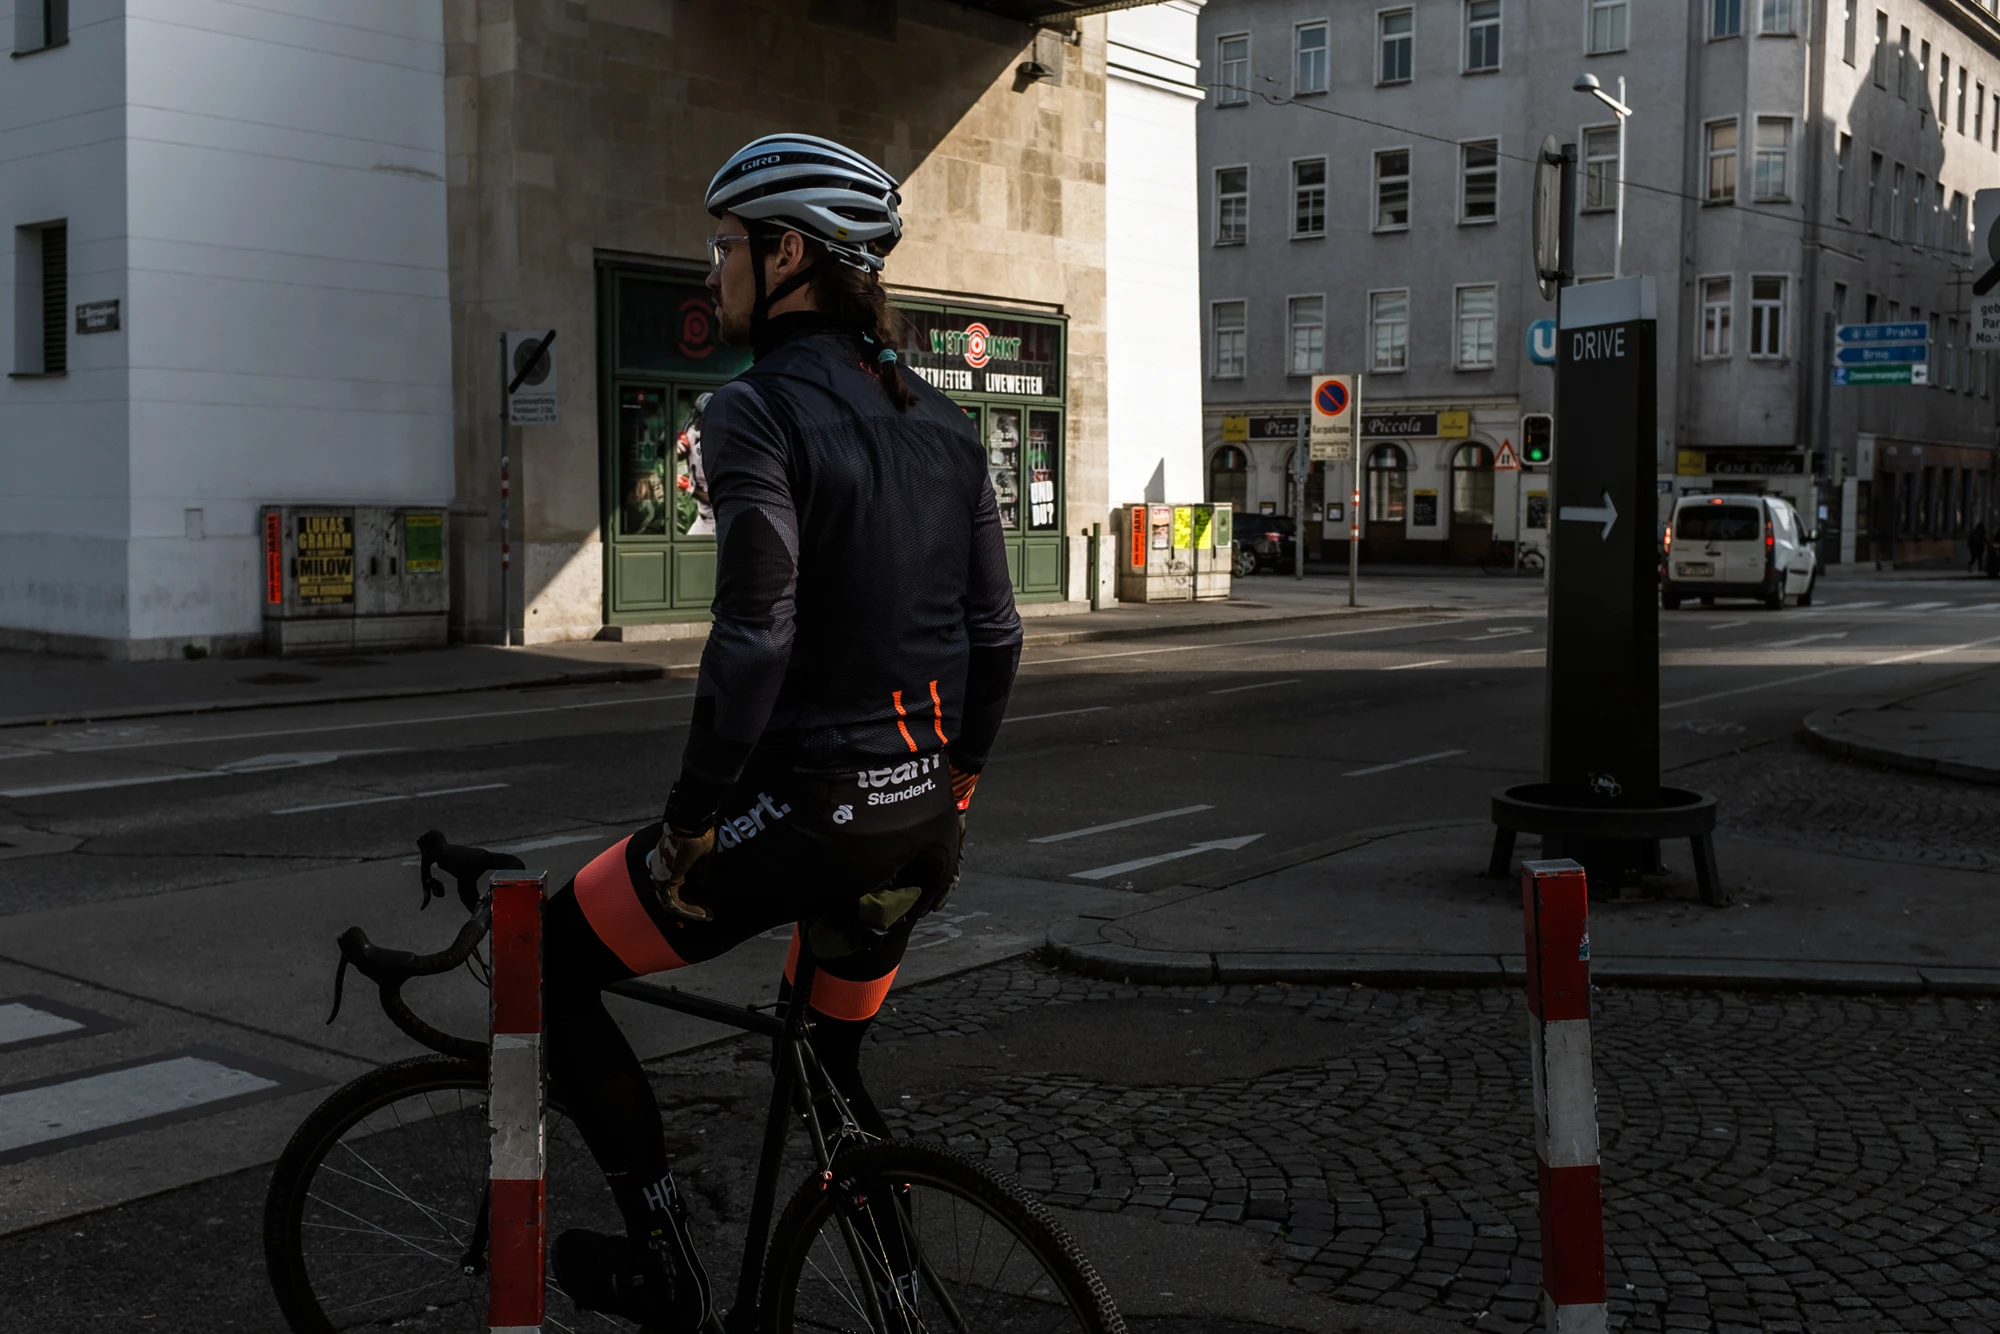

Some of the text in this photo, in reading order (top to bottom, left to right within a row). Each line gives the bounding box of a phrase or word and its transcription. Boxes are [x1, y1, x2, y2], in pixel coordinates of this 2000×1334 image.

[741, 154, 780, 172] GIRO
[1885, 326, 1919, 338] Praha
[1976, 332, 2000, 344] Mo.-
[1572, 327, 1625, 361] DRIVE
[985, 372, 1043, 395] LIVEWETTEN
[1368, 416, 1422, 434] Piccola
[1030, 481, 1053, 504] UND
[1032, 503, 1054, 527] DU?
[305, 516, 345, 533] LUKAS
[299, 532, 352, 549] GRAHAM
[300, 559, 351, 575] MILOW
[867, 778, 936, 806] Standert.
[716, 791, 792, 854] dert.
